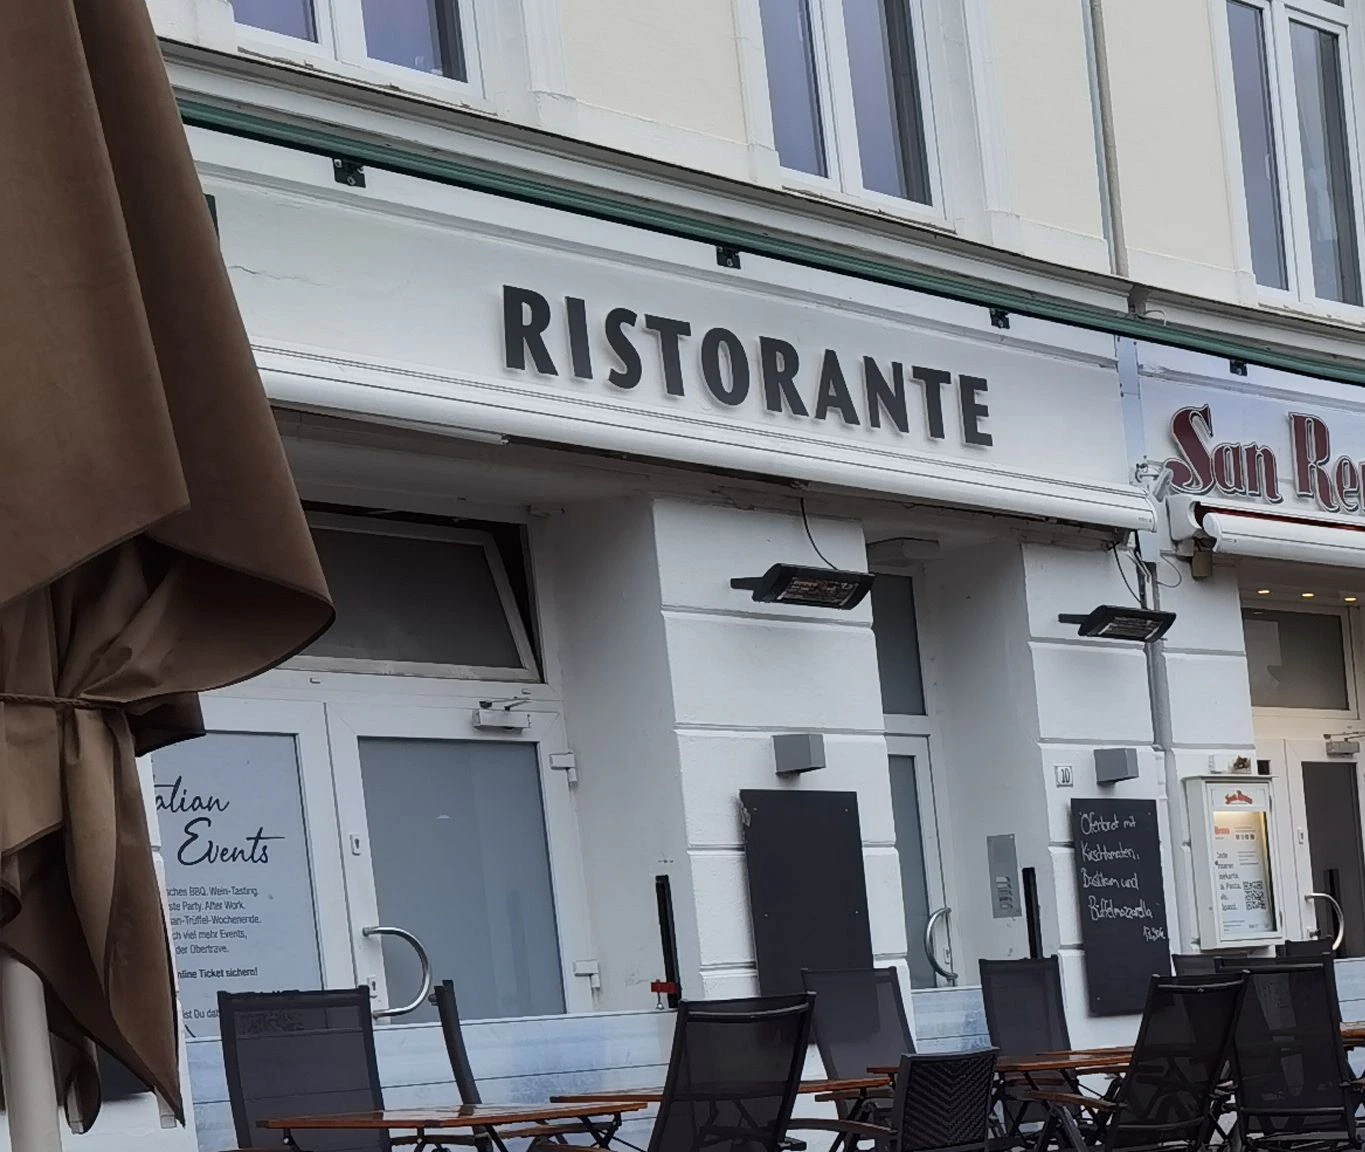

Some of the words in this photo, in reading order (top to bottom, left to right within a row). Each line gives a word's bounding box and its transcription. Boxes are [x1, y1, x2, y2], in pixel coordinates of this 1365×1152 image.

[503, 285, 994, 447] RISTORANTE
[1163, 403, 1283, 504] San
[154, 775, 230, 812] alian
[178, 817, 285, 865] Events
[1121, 872, 1140, 890] und
[199, 969, 224, 978] Ticket
[226, 967, 258, 977] sichern!
[194, 1009, 205, 1019] Du
